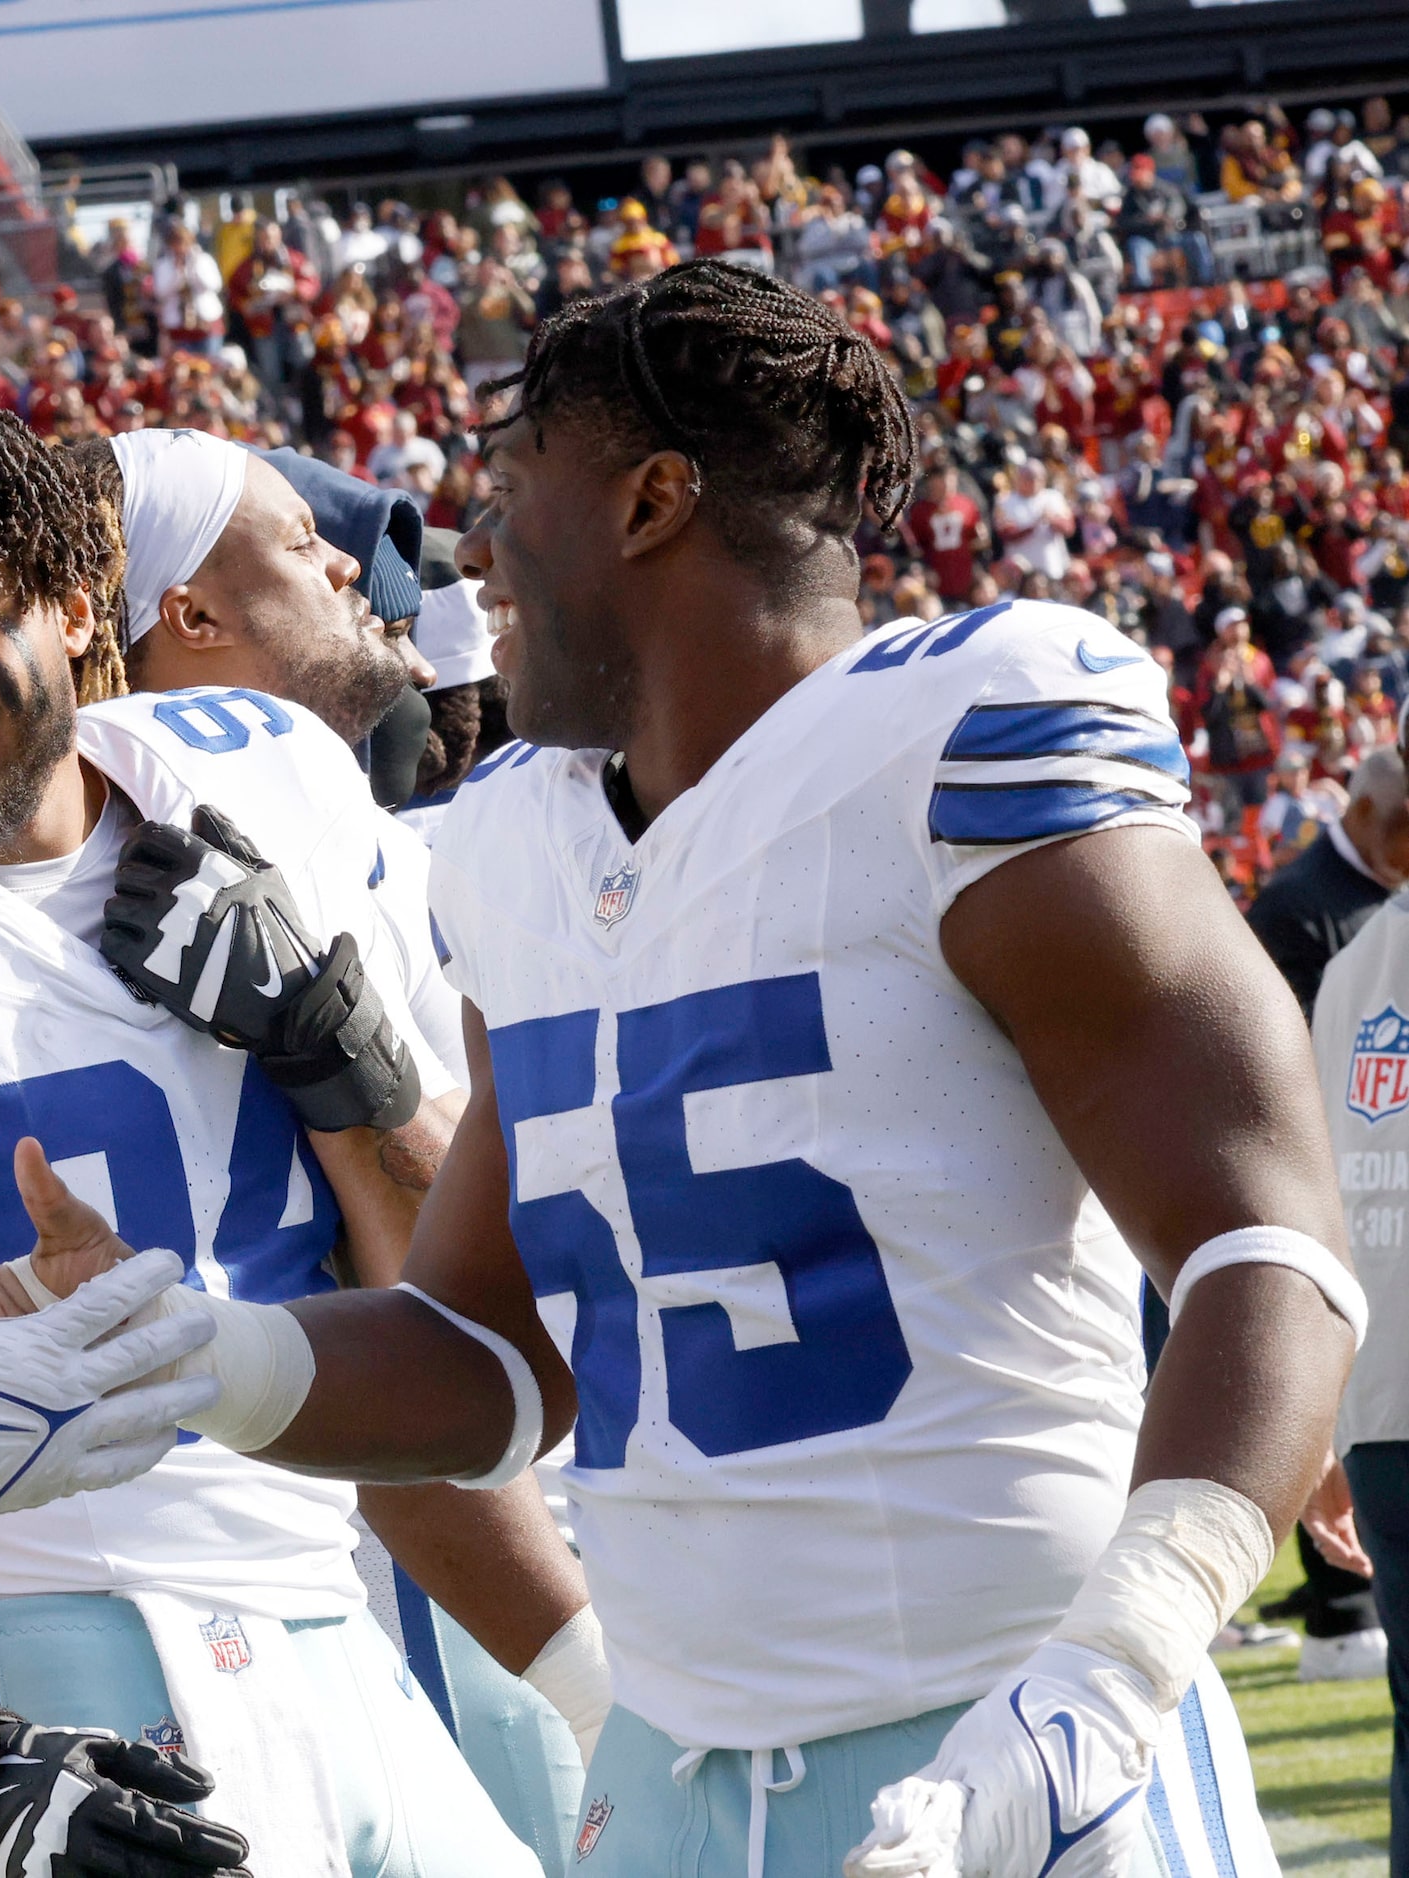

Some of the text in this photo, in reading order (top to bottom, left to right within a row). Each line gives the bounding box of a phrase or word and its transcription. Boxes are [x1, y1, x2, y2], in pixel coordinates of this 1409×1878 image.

[598, 891, 625, 917] NFL
[1350, 1056, 1409, 1110] NFL
[487, 970, 914, 1470] 55
[208, 1639, 248, 1669] NFL
